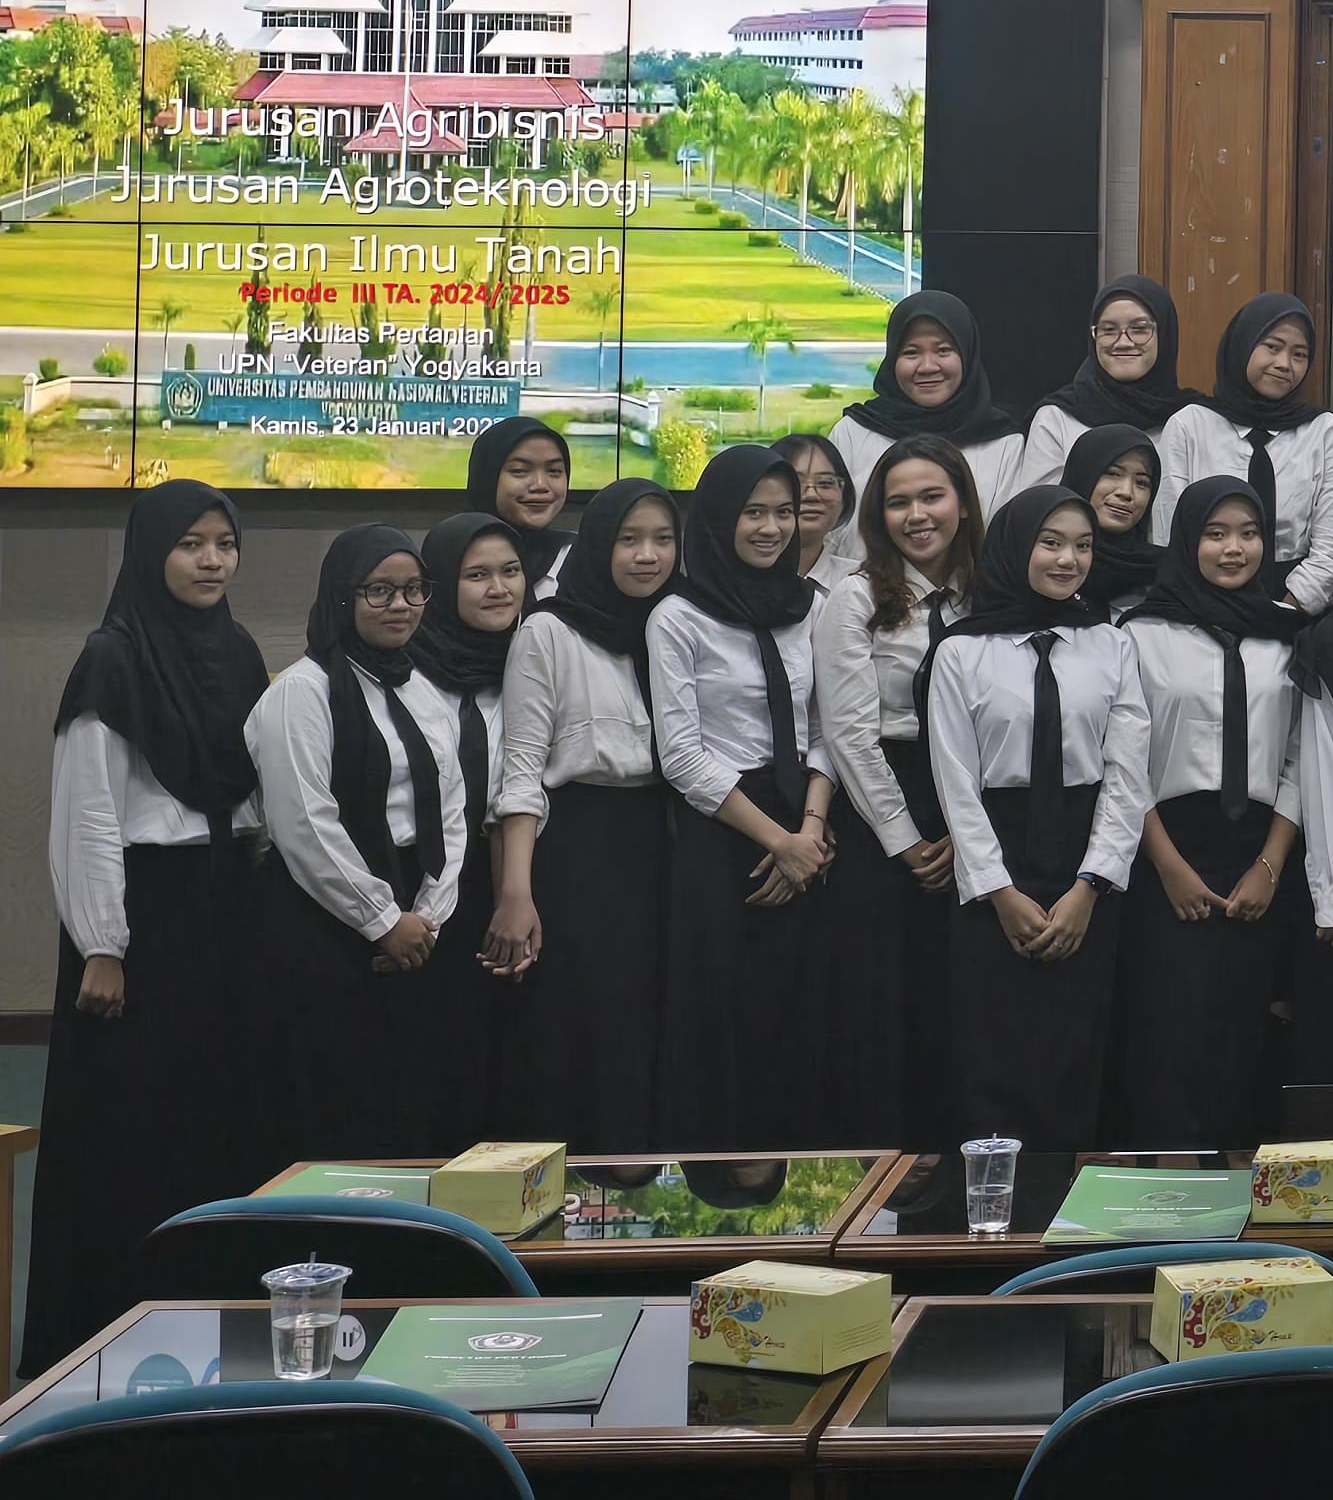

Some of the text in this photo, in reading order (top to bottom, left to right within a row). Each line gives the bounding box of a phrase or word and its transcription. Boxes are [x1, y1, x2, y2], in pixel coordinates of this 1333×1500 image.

[163, 98, 605, 148] Jurusan Agribisnis
[111, 165, 651, 217] Jurusan Agroteknologi
[139, 233, 622, 275] Jurusan Ilmu Tanah
[240, 281, 338, 304] Periode
[352, 283, 373, 304] III
[383, 283, 421, 304] TA.
[268, 321, 494, 344] Fakultas Pertanian
[218, 353, 275, 375] UPN
[406, 354, 542, 381] Yogyakarta
[332, 416, 359, 435] 23
[365, 417, 445, 436] Januari
[452, 417, 505, 436] 202
